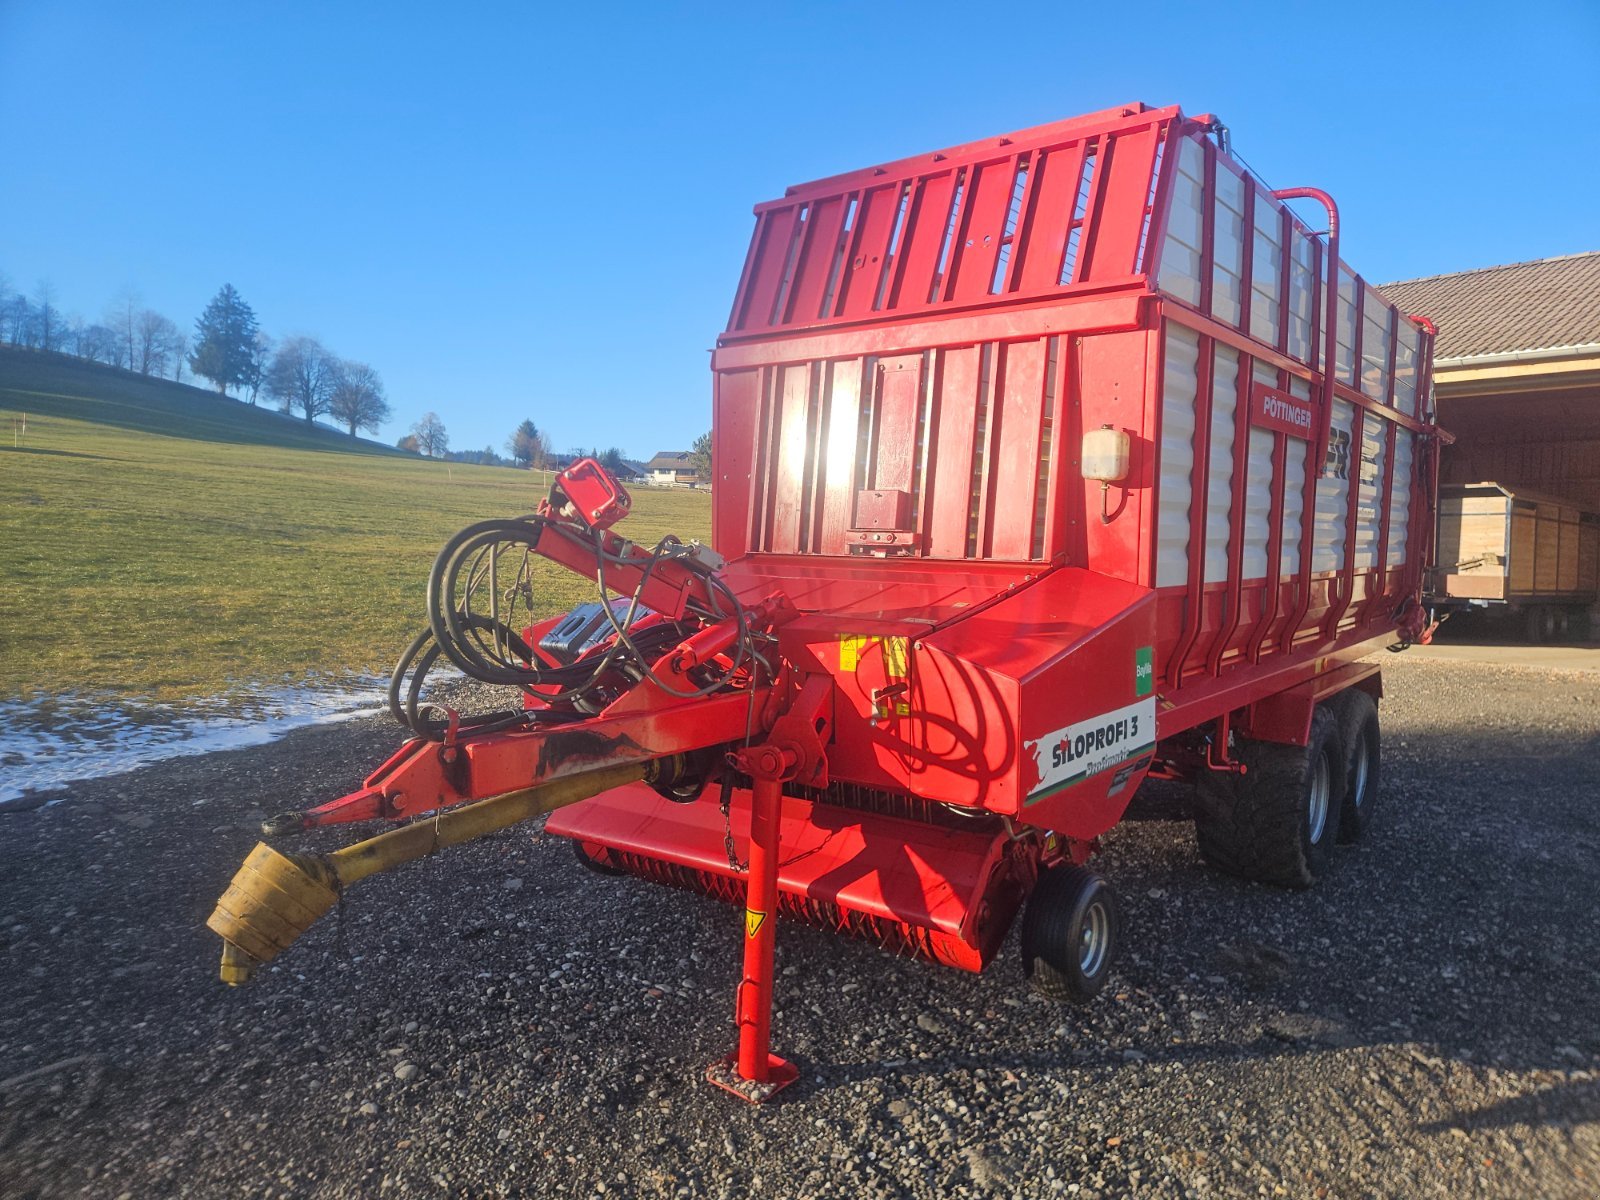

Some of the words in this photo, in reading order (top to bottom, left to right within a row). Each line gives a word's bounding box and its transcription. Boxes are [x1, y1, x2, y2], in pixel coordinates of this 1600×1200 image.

[1263, 396, 1312, 428] PÖTTINGER
[1136, 662, 1152, 678] BayWa
[1130, 715, 1138, 737] 3
